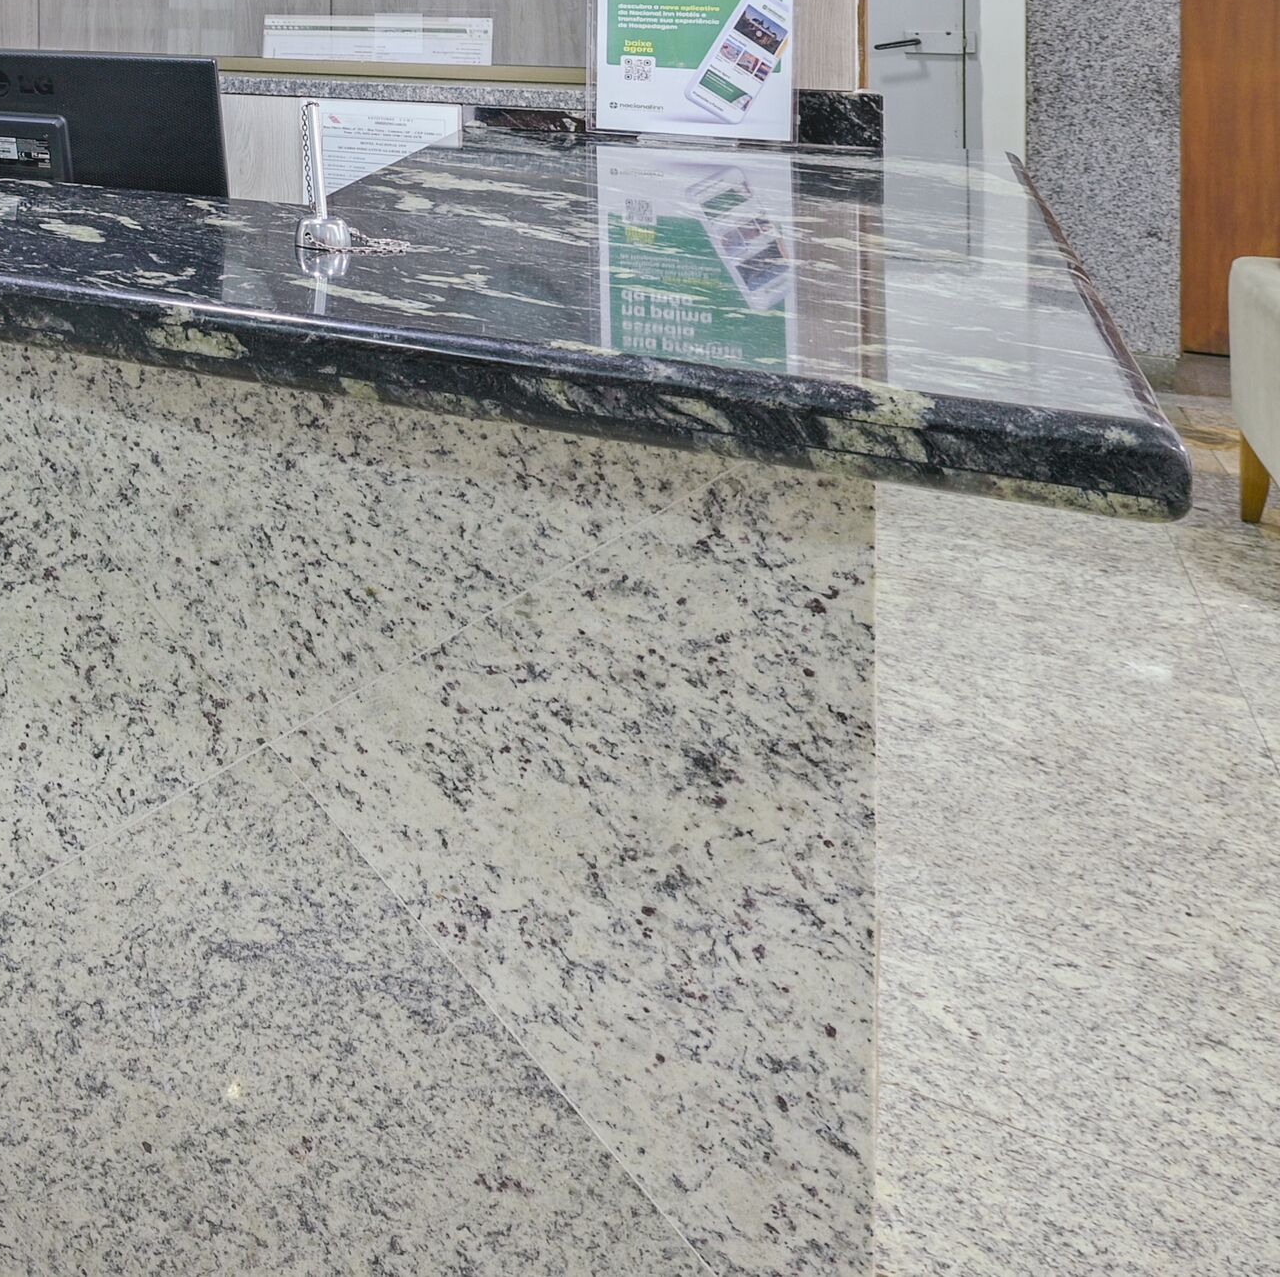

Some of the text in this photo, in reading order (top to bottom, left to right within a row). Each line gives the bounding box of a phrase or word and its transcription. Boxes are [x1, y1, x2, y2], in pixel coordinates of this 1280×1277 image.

[624, 39, 652, 47] baixe
[623, 46, 654, 54] agora
[18, 75, 55, 95] LG
